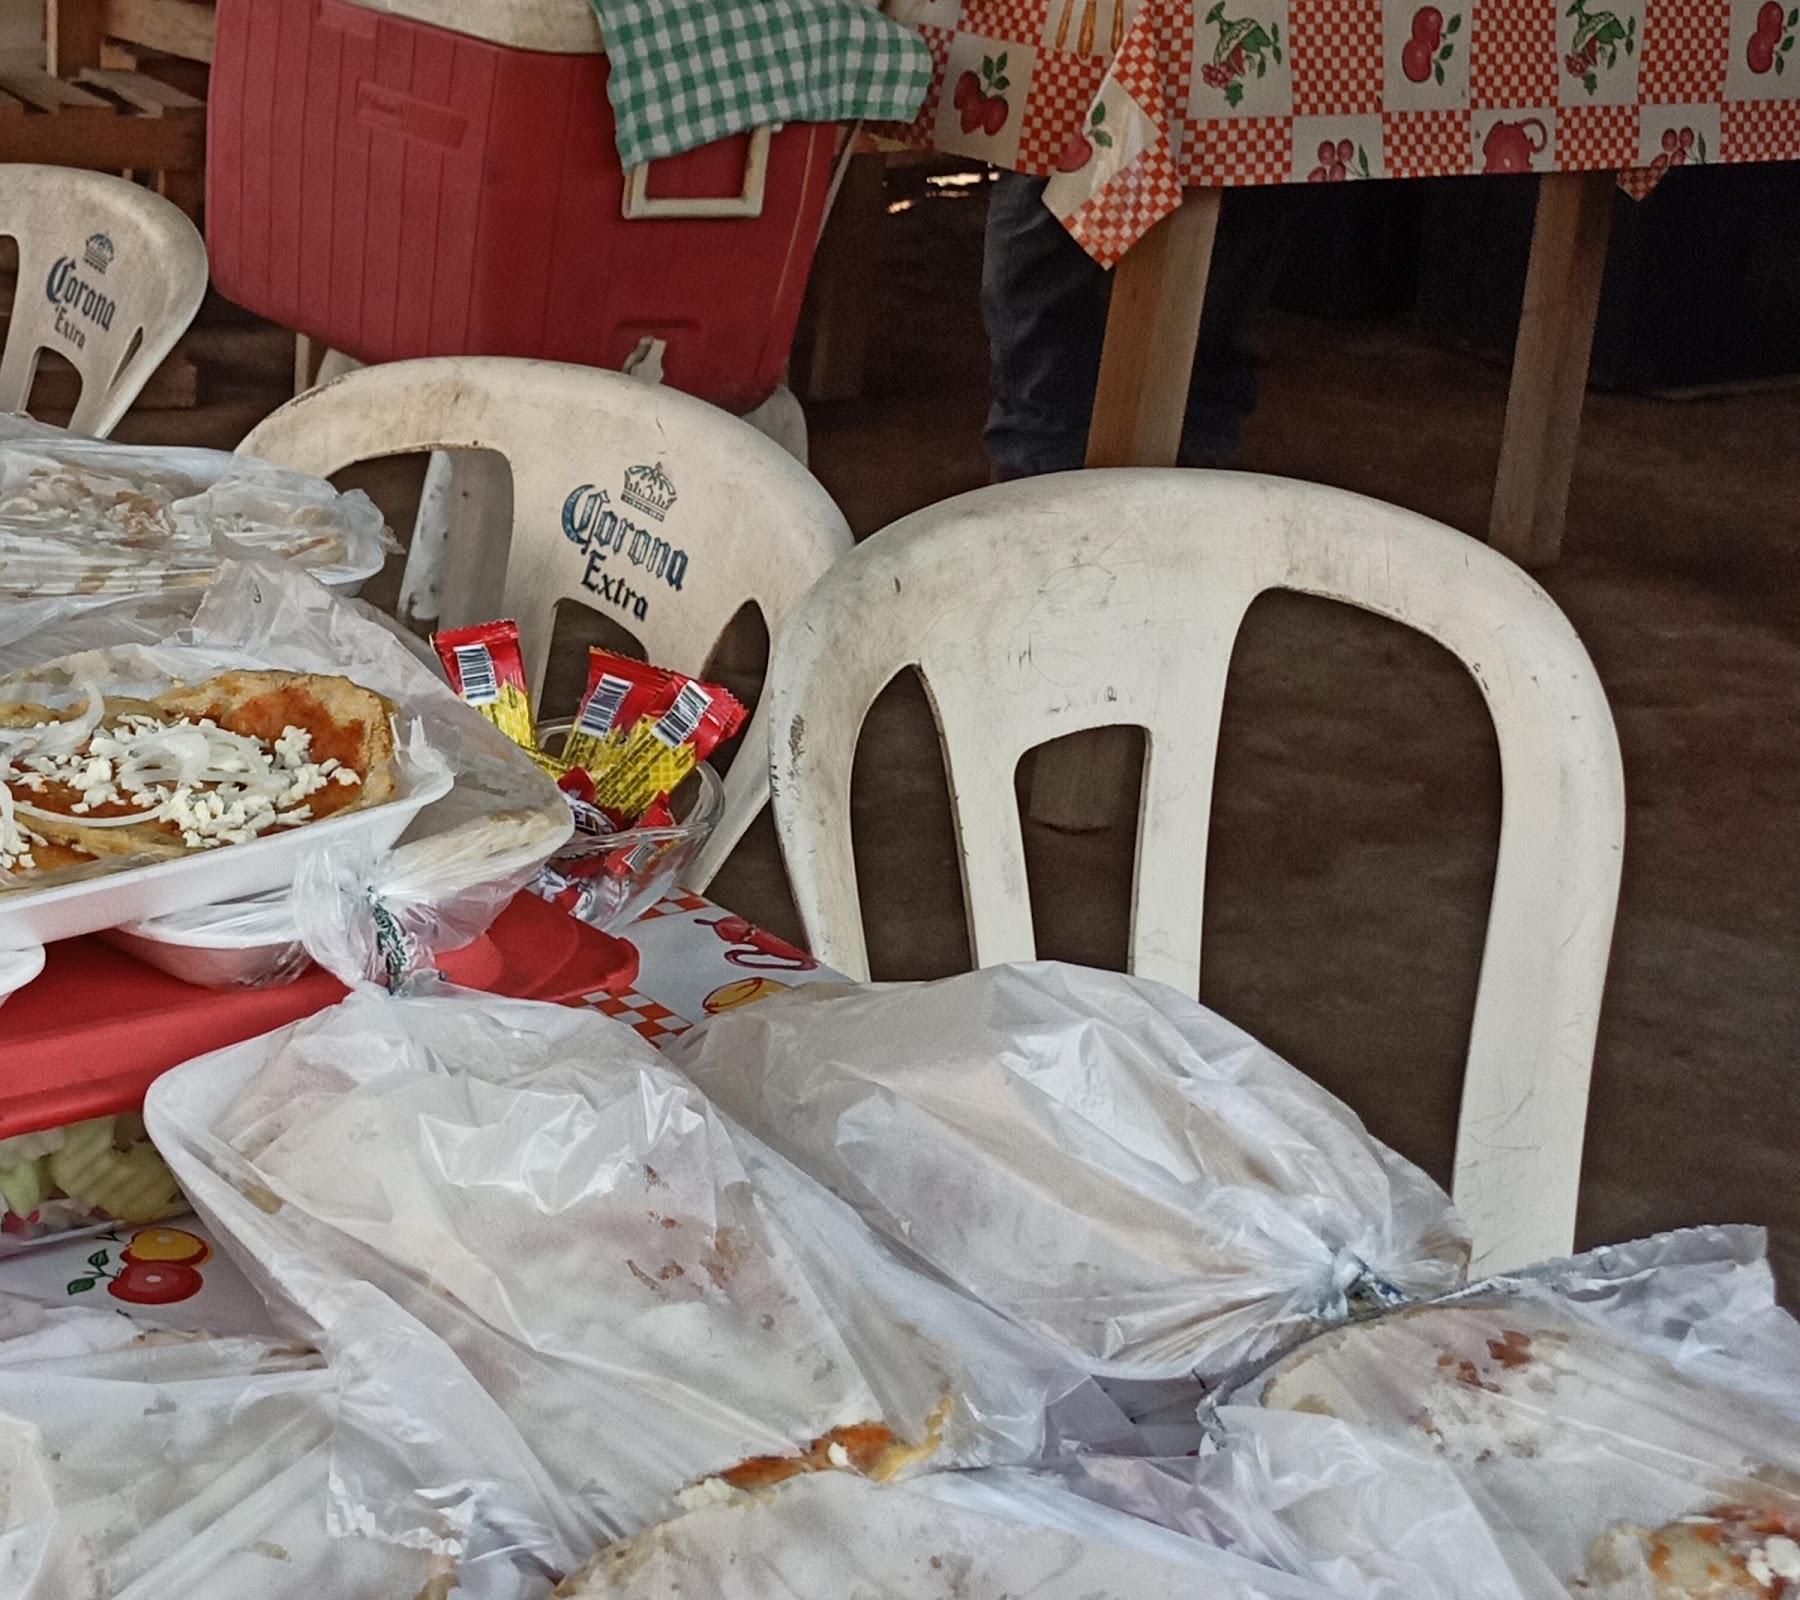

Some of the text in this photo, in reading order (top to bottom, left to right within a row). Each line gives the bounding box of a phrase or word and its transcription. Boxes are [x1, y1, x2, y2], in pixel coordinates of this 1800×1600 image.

[46, 256, 116, 332] Corona
[54, 306, 86, 349] Extra
[561, 483, 689, 591] Corona
[580, 549, 649, 622] Extra
